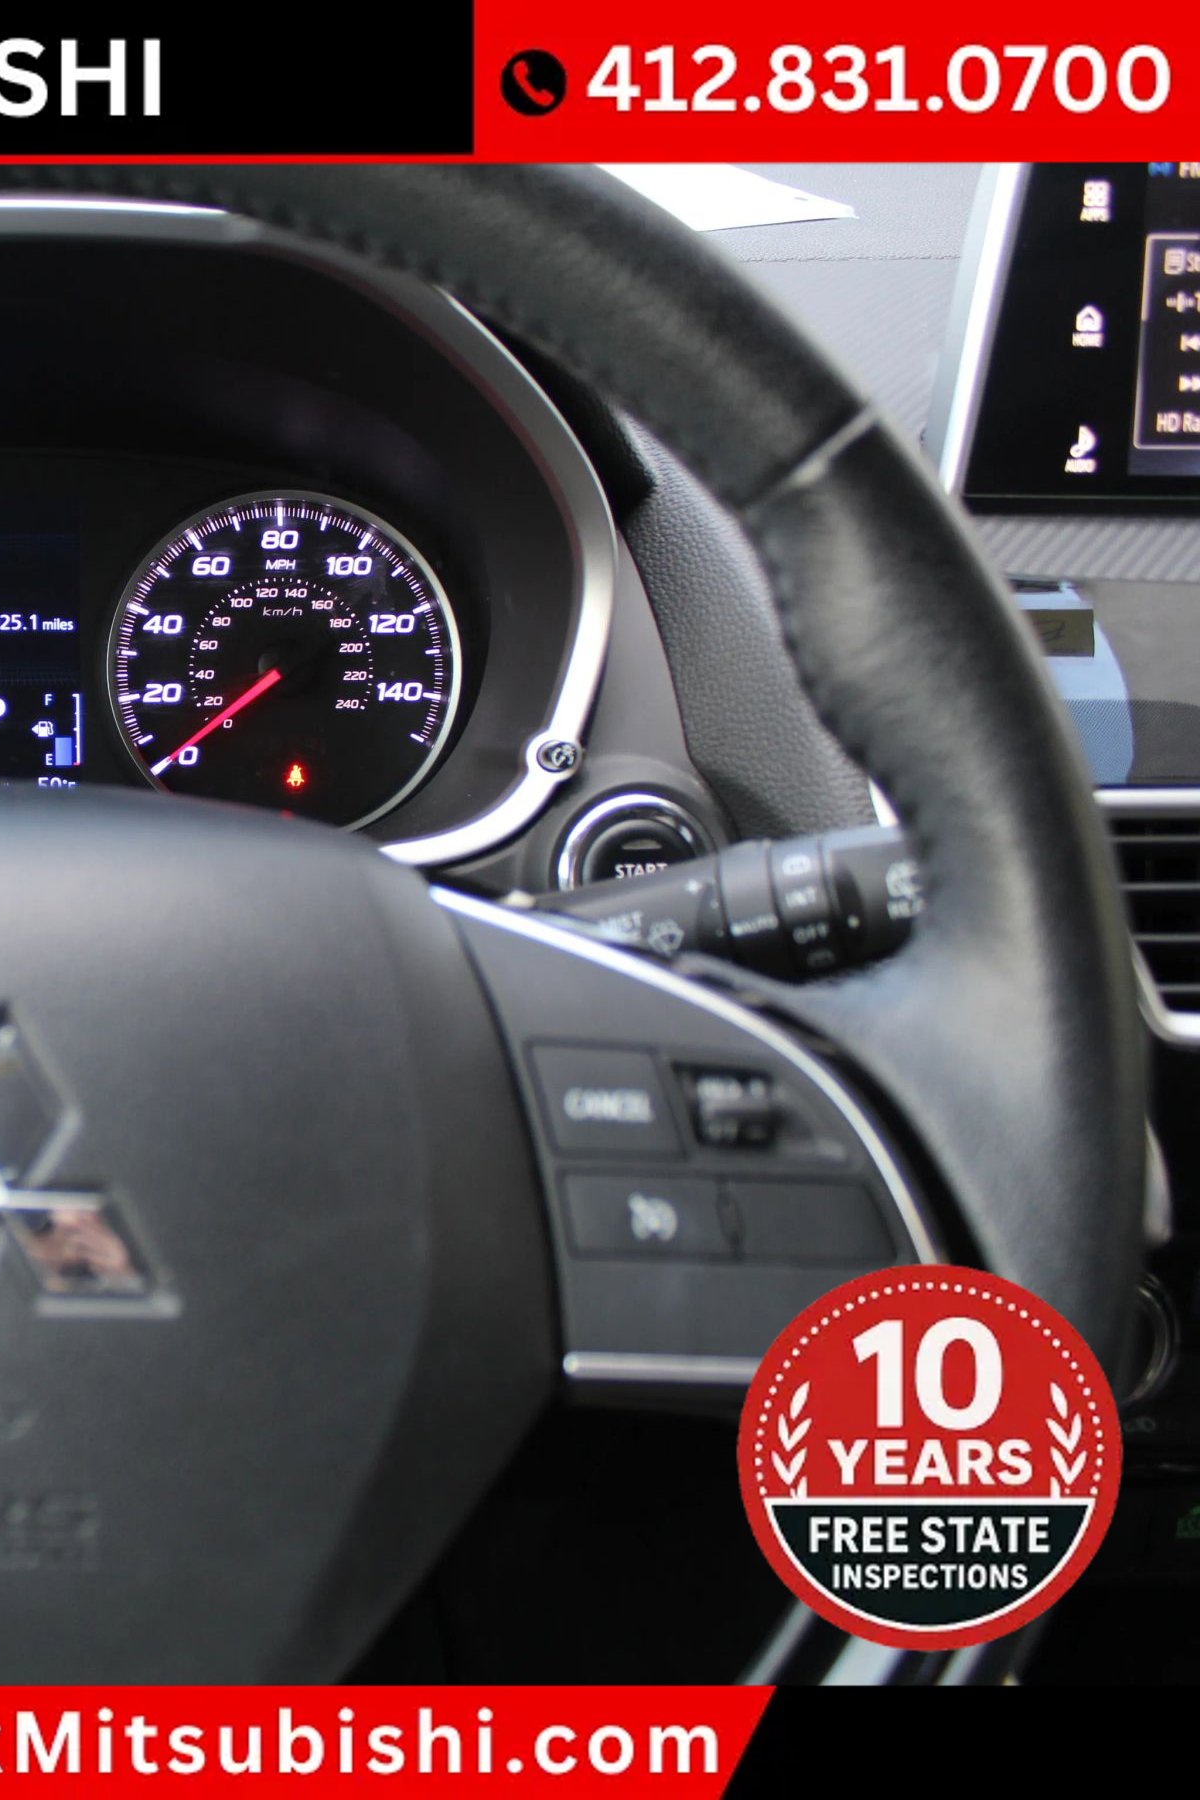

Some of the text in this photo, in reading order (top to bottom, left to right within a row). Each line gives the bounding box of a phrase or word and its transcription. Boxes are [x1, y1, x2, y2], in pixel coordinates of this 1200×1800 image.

[1072, 332, 1104, 348] HOME
[1156, 412, 1181, 433] HD
[1064, 458, 1097, 473] AUDIO
[260, 529, 299, 550] 80
[191, 556, 231, 576] 60
[265, 558, 297, 571] MPH
[326, 555, 373, 576] 100
[255, 587, 279, 598] 120
[284, 588, 308, 599] 140
[229, 597, 253, 608] 100
[310, 599, 334, 610] 160
[262, 606, 303, 616] km/h
[42, 616, 75, 631] miles
[142, 614, 183, 635] 40
[211, 616, 231, 627] 80
[329, 617, 352, 628] 180
[368, 614, 415, 634] 120
[199, 639, 219, 651] 60
[338, 642, 364, 653] 200
[194, 669, 215, 680] 40
[342, 670, 367, 681] 220
[142, 683, 183, 703] 20
[376, 682, 423, 702] 140
[44, 693, 53, 706] F
[203, 696, 223, 706] 20
[335, 699, 360, 709] 240
[222, 718, 233, 729] 0
[45, 753, 53, 766] E
[178, 745, 199, 766] 0
